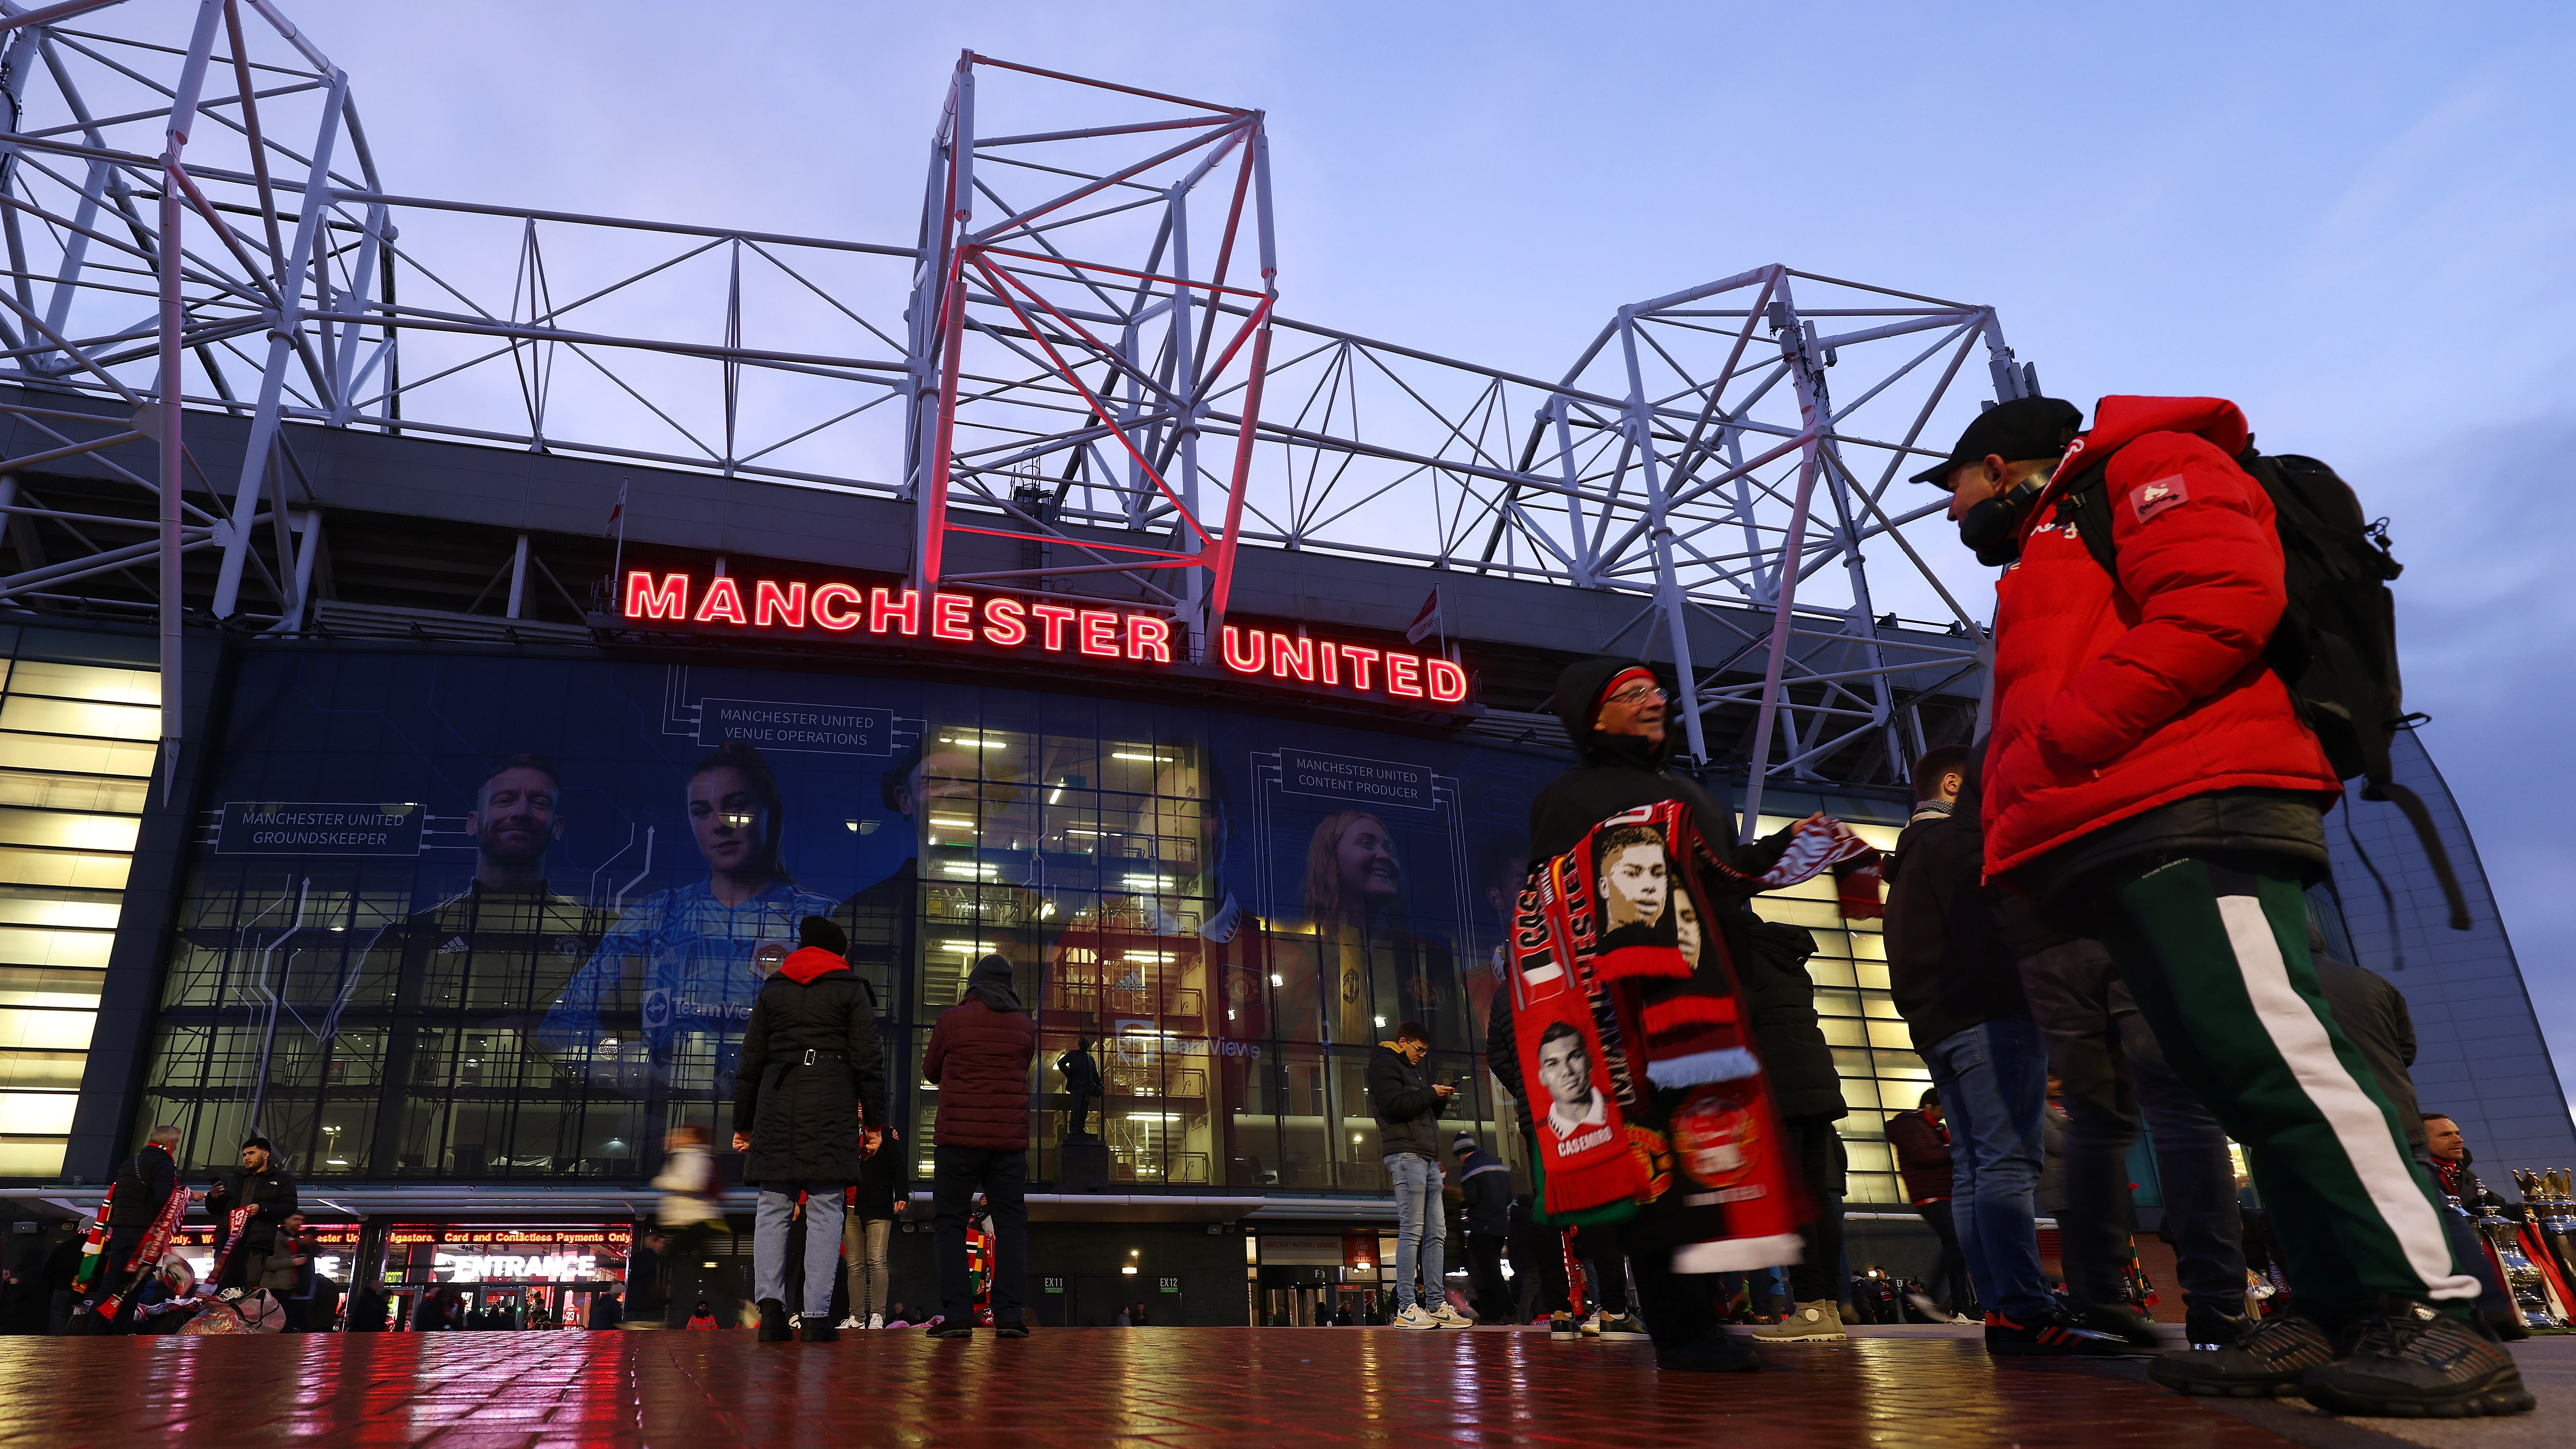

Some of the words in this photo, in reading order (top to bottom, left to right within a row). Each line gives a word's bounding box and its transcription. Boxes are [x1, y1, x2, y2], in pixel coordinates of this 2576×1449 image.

[624, 570, 1170, 663] MANCHESTER
[1221, 625, 1468, 703] UNITED
[721, 708, 818, 725] MANCHESTER
[821, 715, 874, 728] UNITED
[724, 727, 773, 740] VENUE
[777, 729, 868, 746] OPERATIONS
[1296, 758, 1373, 777] MANCHESTER
[1376, 769, 1418, 783] UNITED
[1298, 774, 1354, 791] CONTENT
[1357, 782, 1418, 799] PRODUCER
[242, 812, 344, 826] MANCHESTER
[348, 814, 404, 827] UNITED
[252, 831, 388, 845] GROUNDSKEEPER
[437, 944, 469, 954] adidas
[1115, 981, 1147, 992] adidas
[671, 997, 752, 1021] TeamVie
[390, 1234, 435, 1244] egastore.
[444, 1232, 468, 1242] Card
[473, 1233, 491, 1242] and
[496, 1232, 552, 1242] Contactless
[556, 1232, 604, 1244] Payments
[460, 1255, 596, 1278] ENTRANCE
[1045, 1278, 1063, 1287] EX11
[1160, 1278, 1177, 1287] EX12
[566, 1311, 575, 1321] 23
